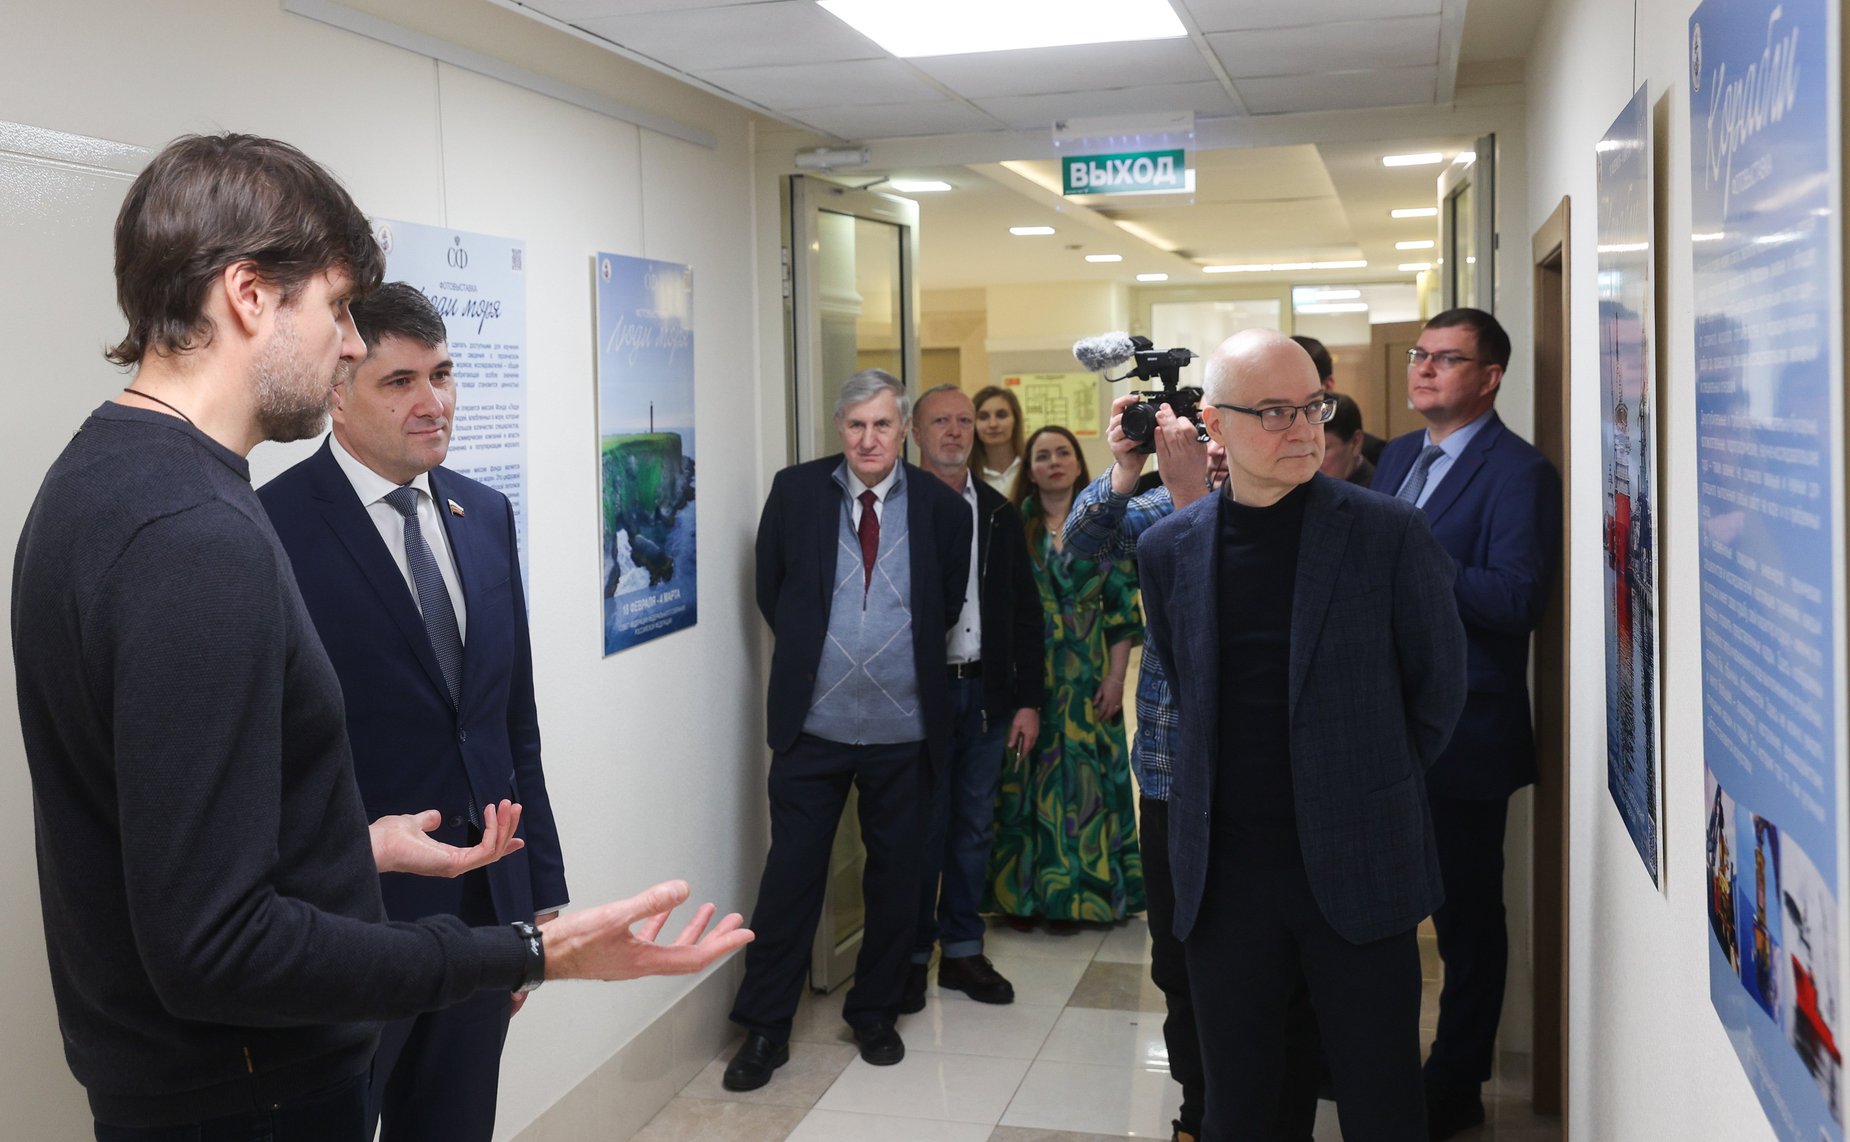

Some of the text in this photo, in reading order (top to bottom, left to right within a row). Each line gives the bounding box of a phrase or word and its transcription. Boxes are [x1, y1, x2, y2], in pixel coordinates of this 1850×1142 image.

[1070, 156, 1176, 188] ВЫХОД
[447, 247, 468, 269] СФ
[461, 298, 502, 335] моря
[606, 313, 652, 367] Люди
